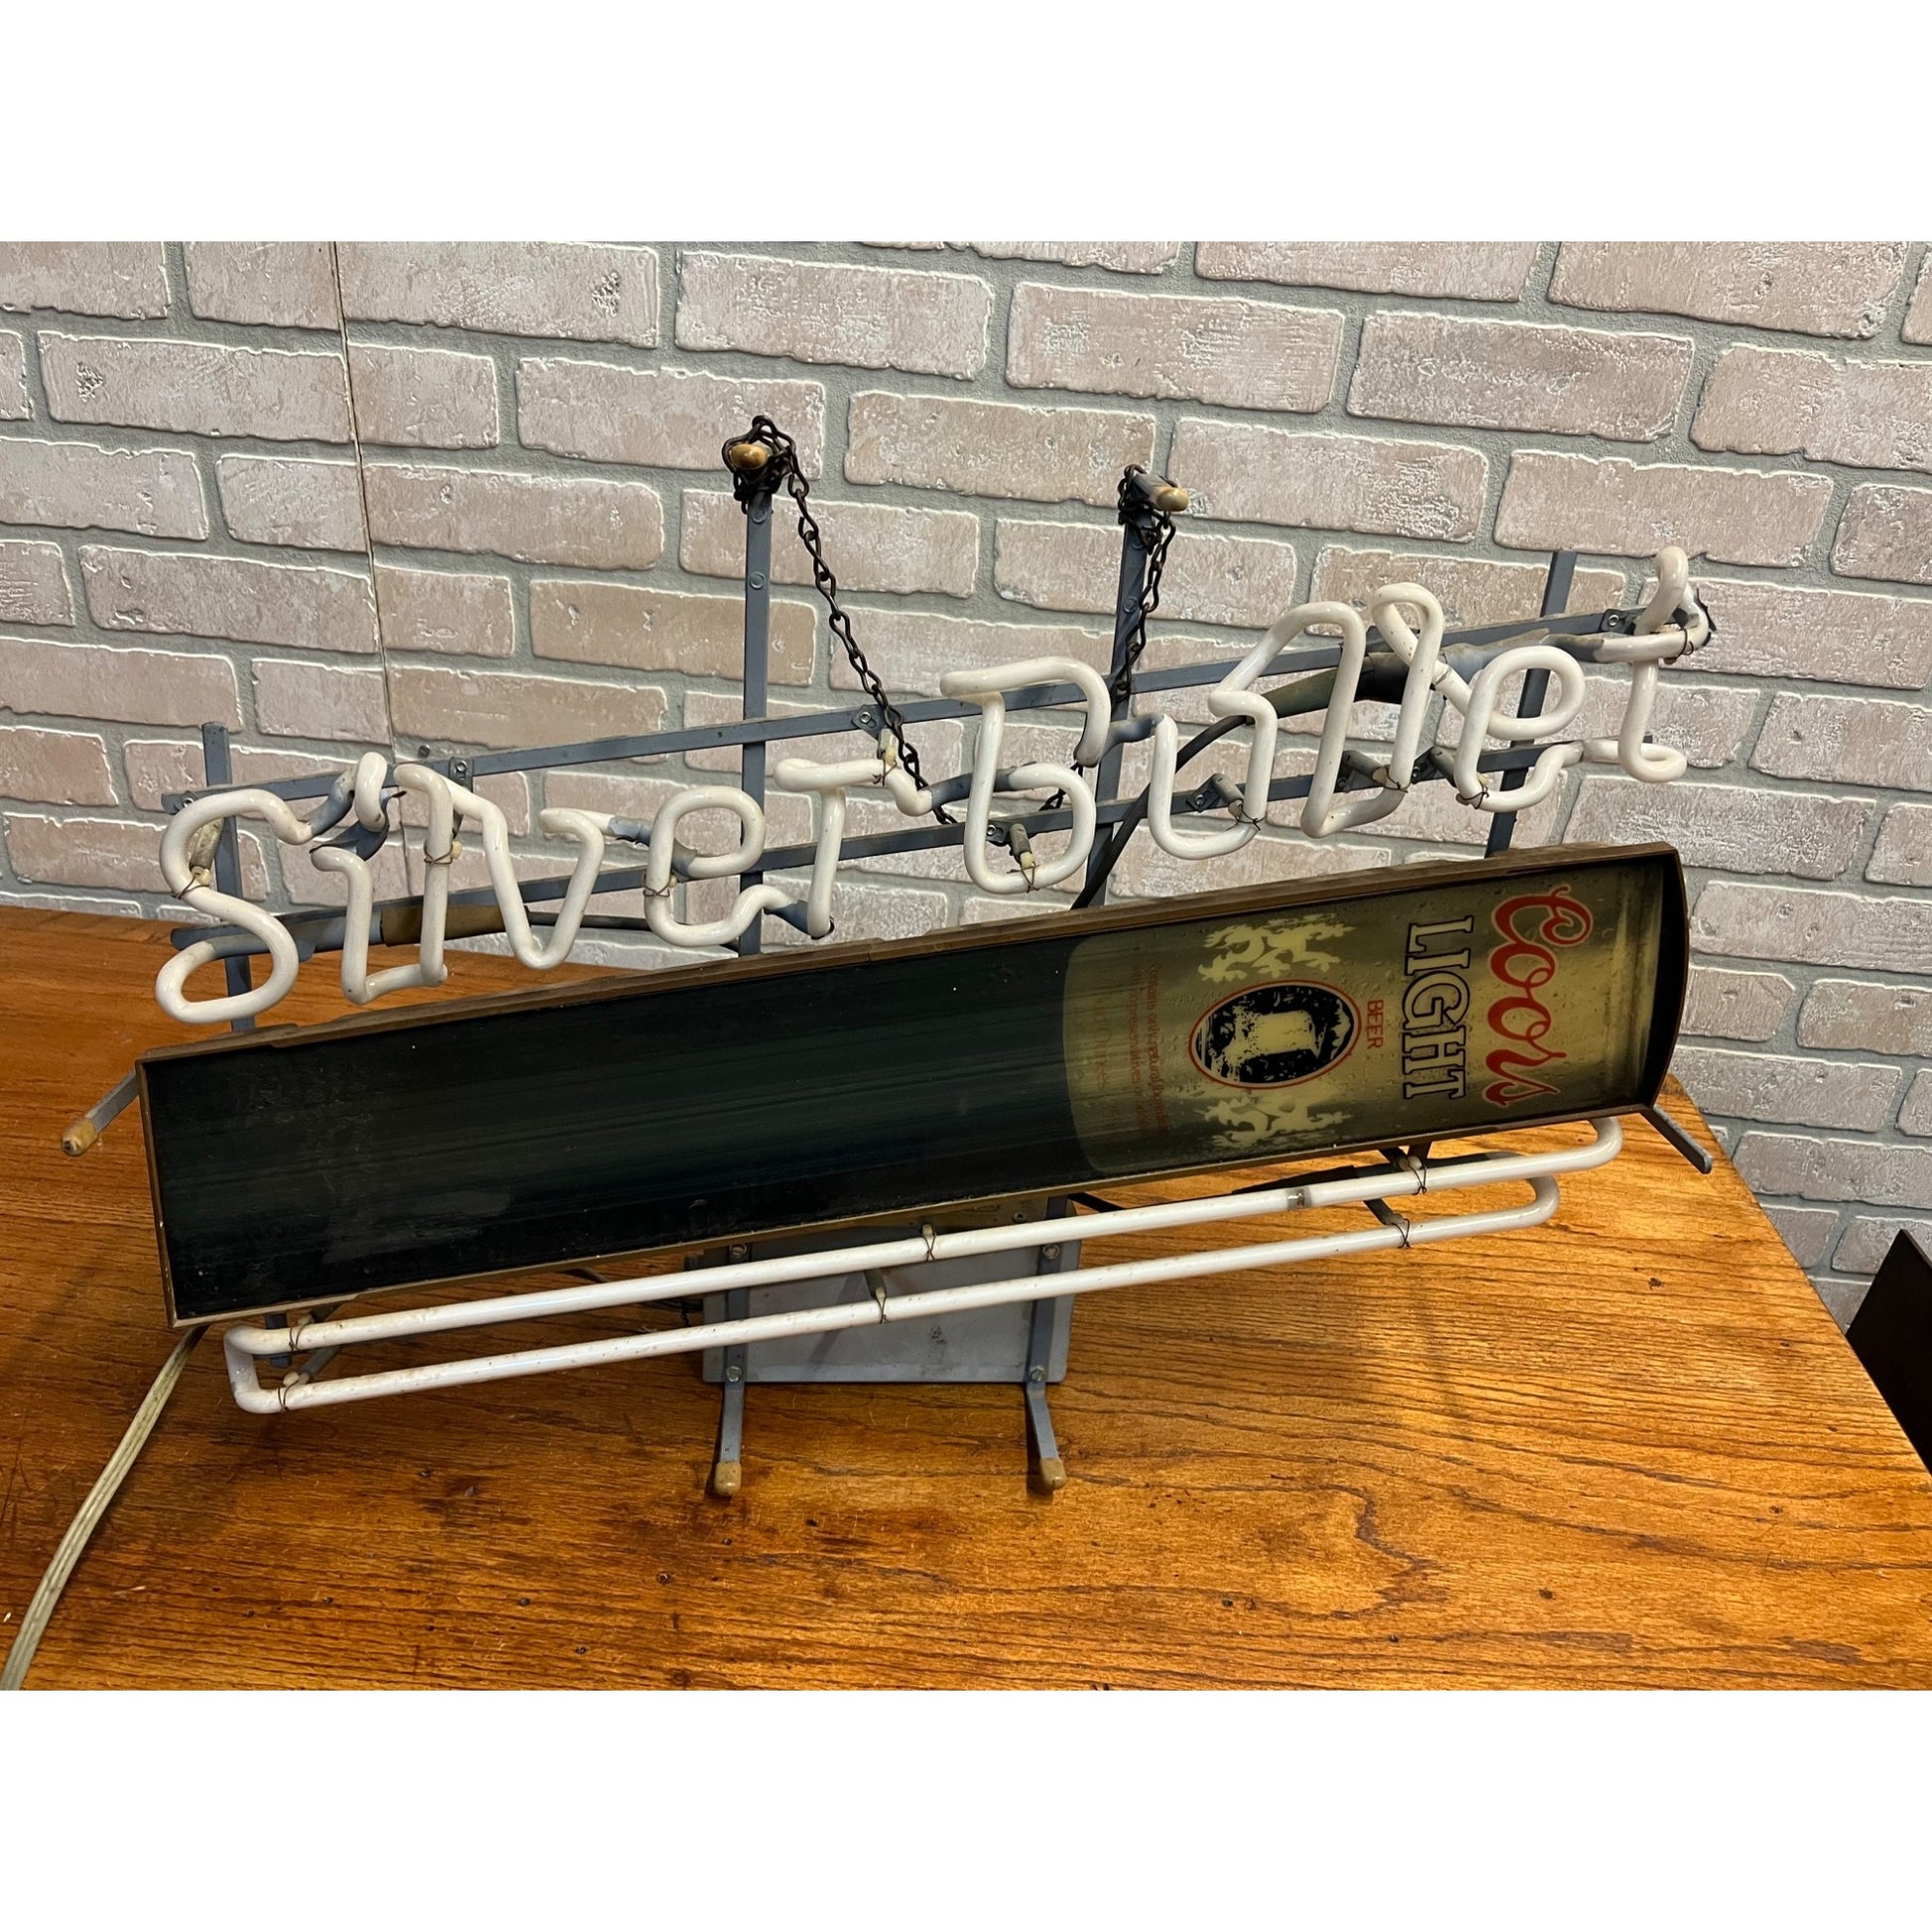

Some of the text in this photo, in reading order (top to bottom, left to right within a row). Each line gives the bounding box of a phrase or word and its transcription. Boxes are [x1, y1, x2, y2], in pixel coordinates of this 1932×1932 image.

[1365, 999, 1386, 1050] BEER
[1401, 914, 1475, 1101] LIGHT
[1482, 885, 1591, 1109] Coors
